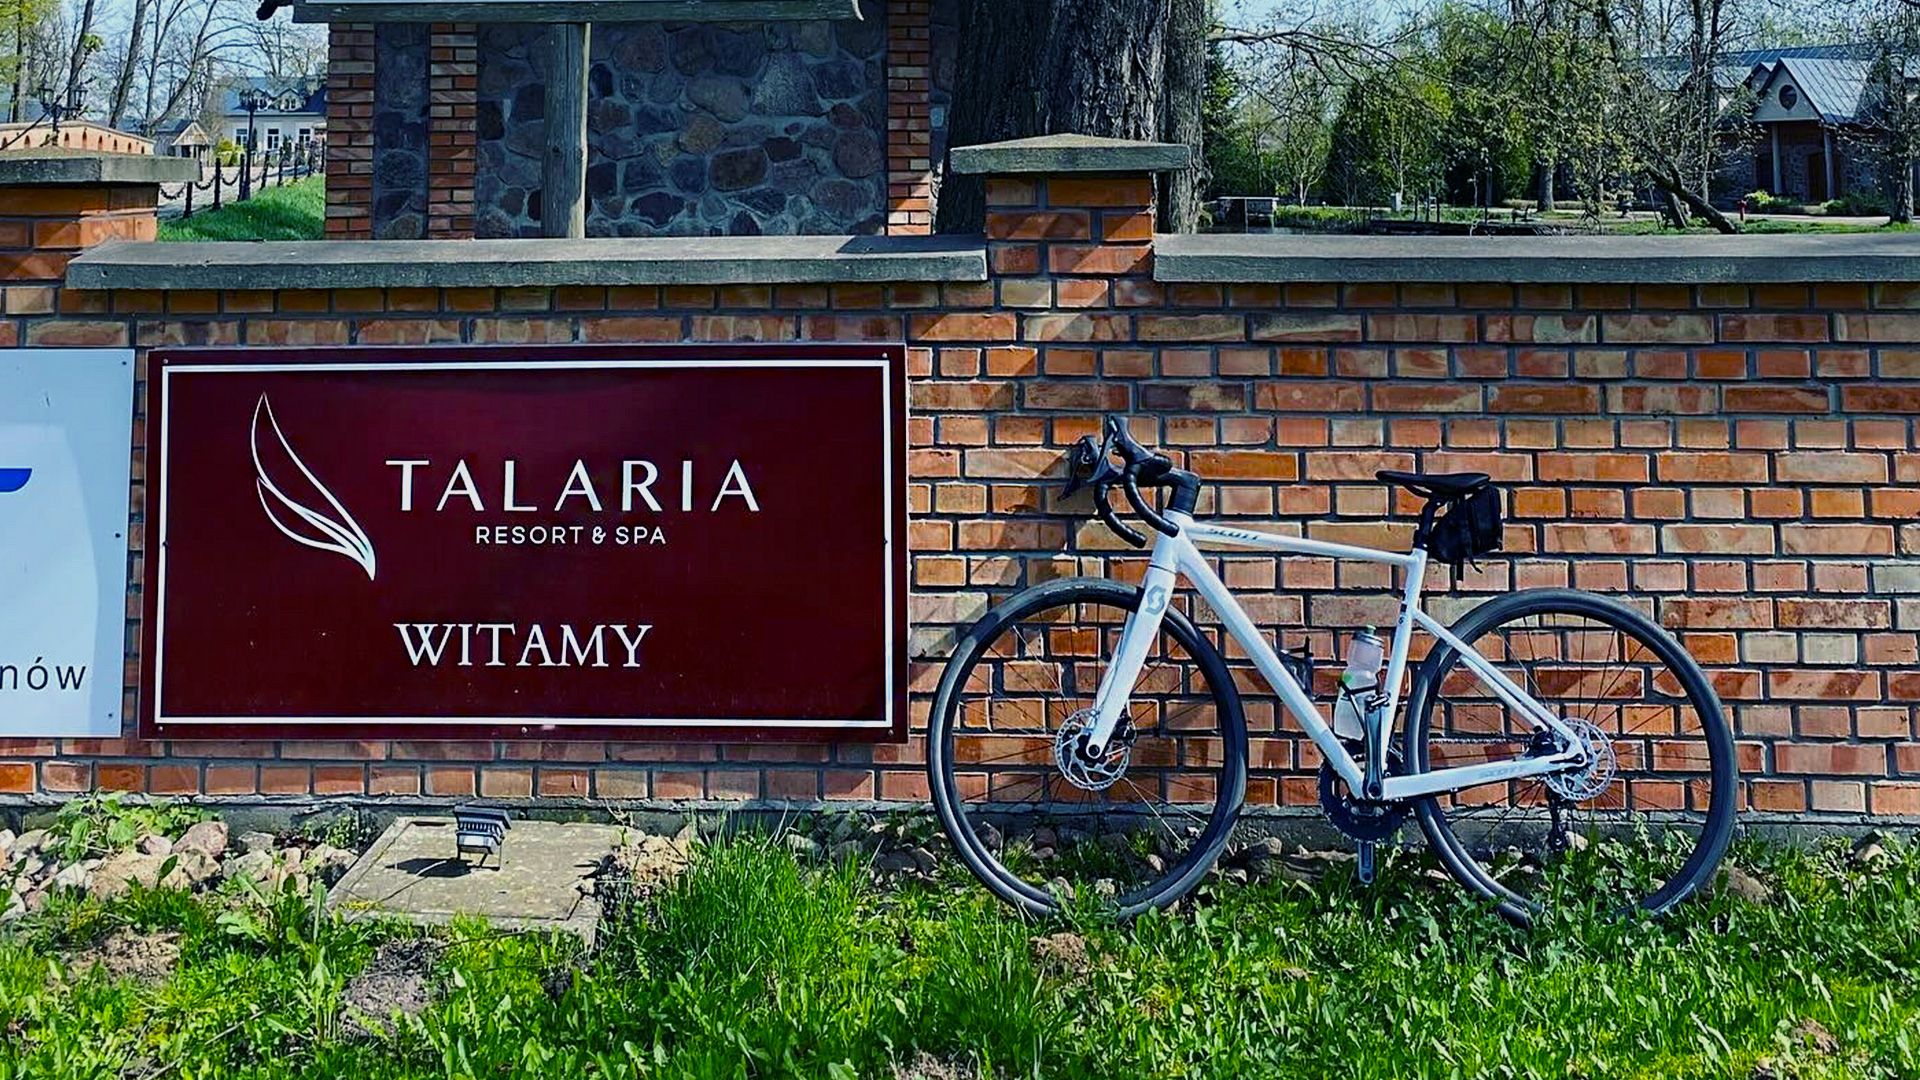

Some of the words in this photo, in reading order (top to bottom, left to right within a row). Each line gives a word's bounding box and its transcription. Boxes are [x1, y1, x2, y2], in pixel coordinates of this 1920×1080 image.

[386, 459, 760, 512] TALARIA
[476, 525, 584, 545] RESORT
[591, 525, 607, 545] &
[615, 525, 667, 545] SPA
[393, 623, 653, 668] WITAMY
[0, 656, 86, 691] nów
